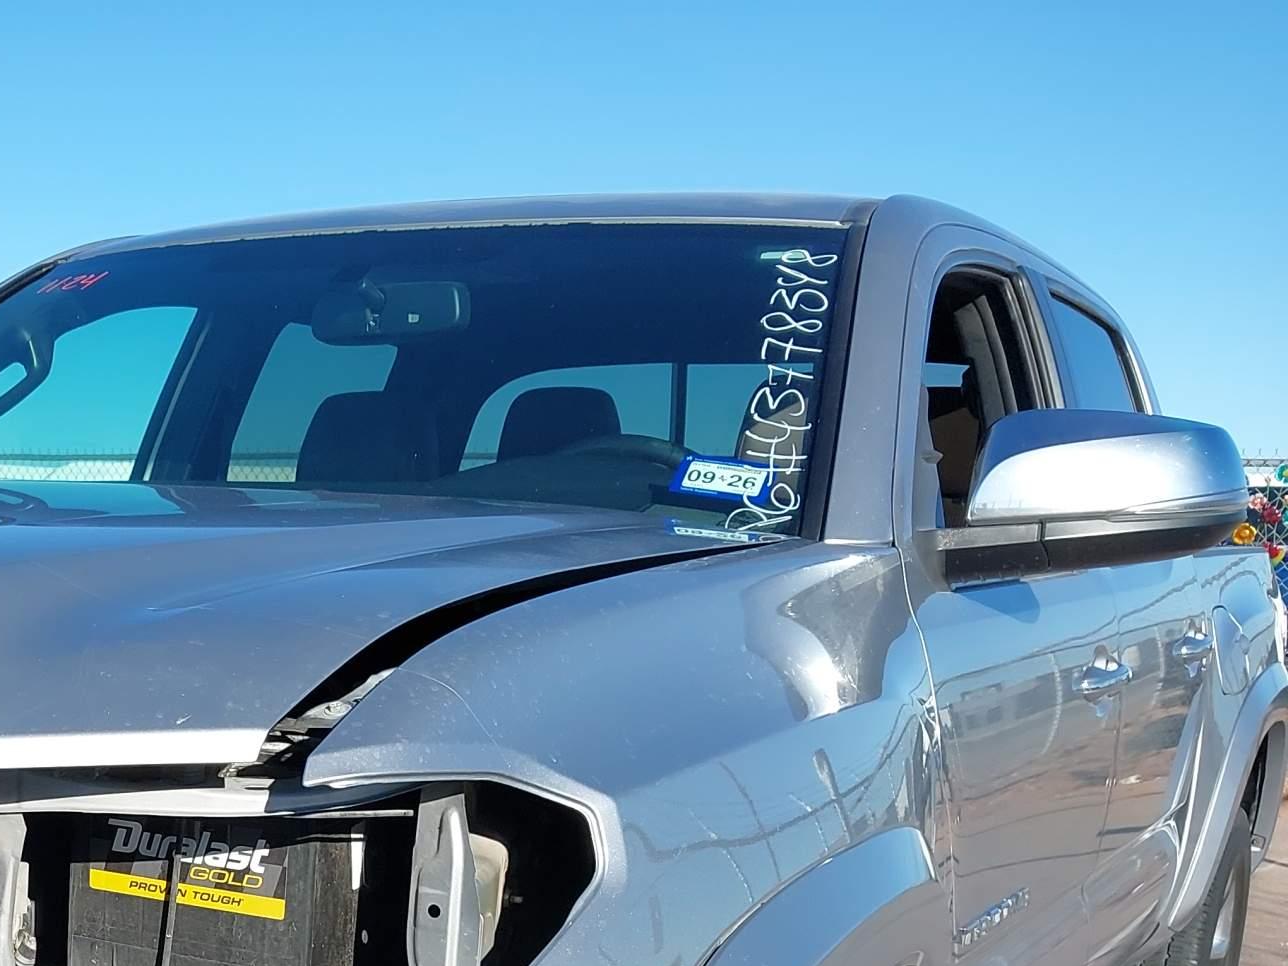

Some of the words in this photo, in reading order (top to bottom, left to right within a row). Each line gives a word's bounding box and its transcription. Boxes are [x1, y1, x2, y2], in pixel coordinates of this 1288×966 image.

[687, 468, 716, 484] 09
[727, 474, 758, 490] 26
[107, 818, 270, 874] Duralast
[189, 865, 264, 889] GOLD
[128, 880, 187, 898] PROVN
[192, 890, 242, 907] TOUGH
